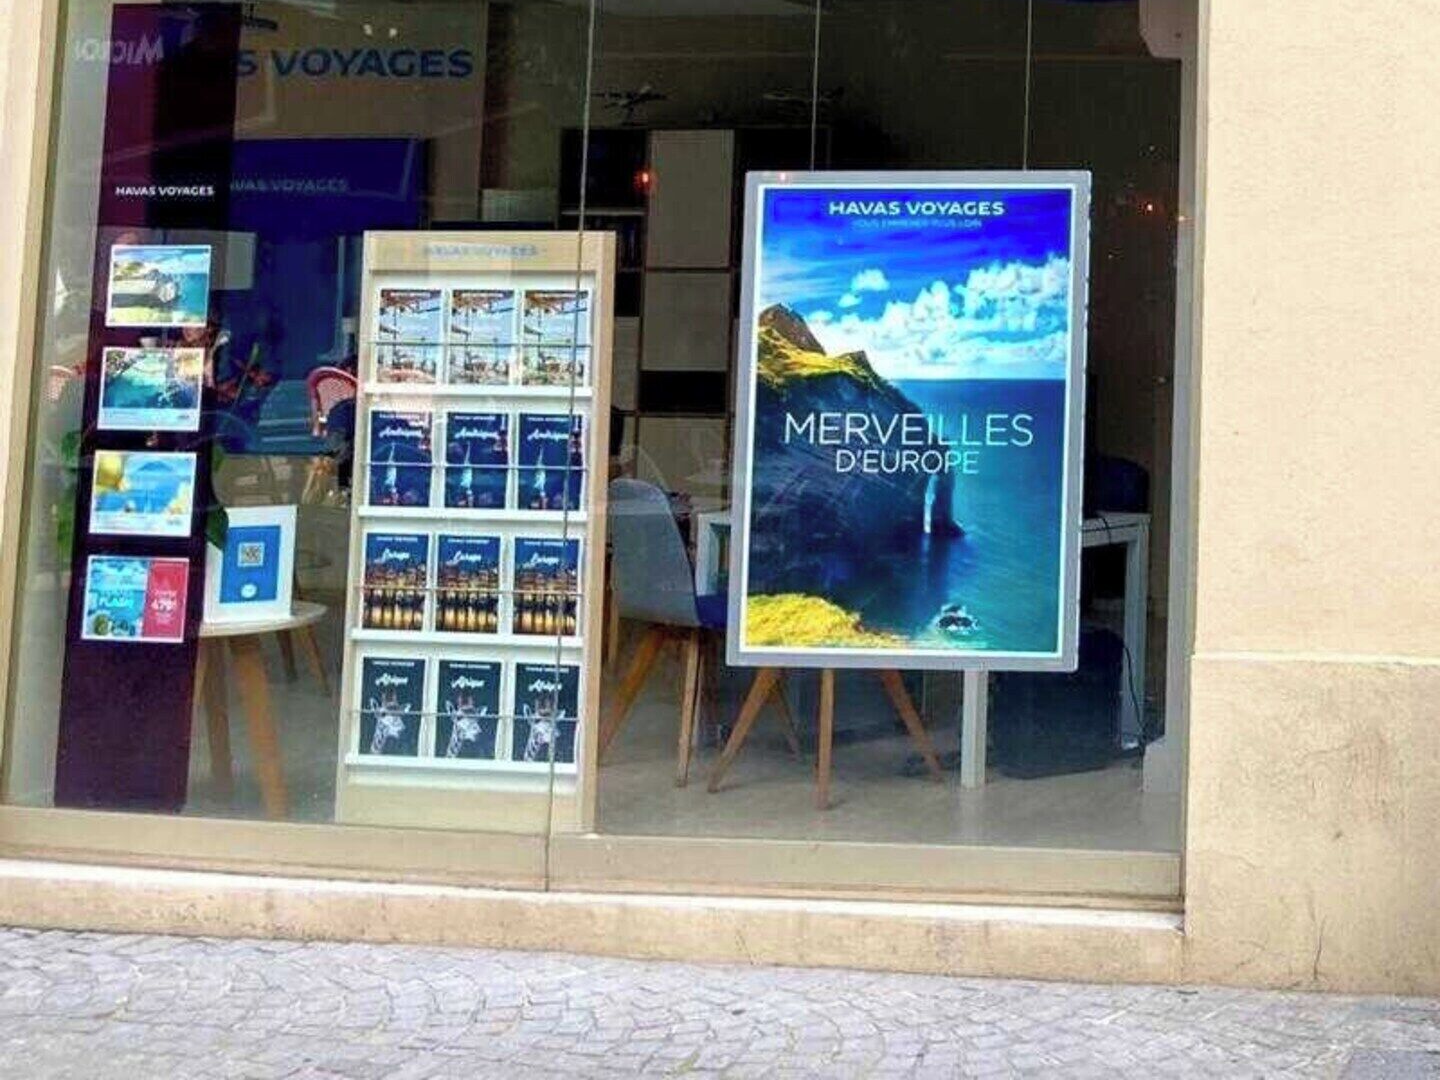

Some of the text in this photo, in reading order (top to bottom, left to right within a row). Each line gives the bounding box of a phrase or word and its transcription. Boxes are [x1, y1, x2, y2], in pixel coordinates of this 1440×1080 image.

[270, 48, 474, 78] VOYAGES
[115, 186, 215, 197] HAVAS VOYAGES
[828, 201, 1005, 215] HAVAS VOYAGES
[784, 412, 1034, 447] MERVEILLES
[836, 449, 980, 474] D'EUROPE
